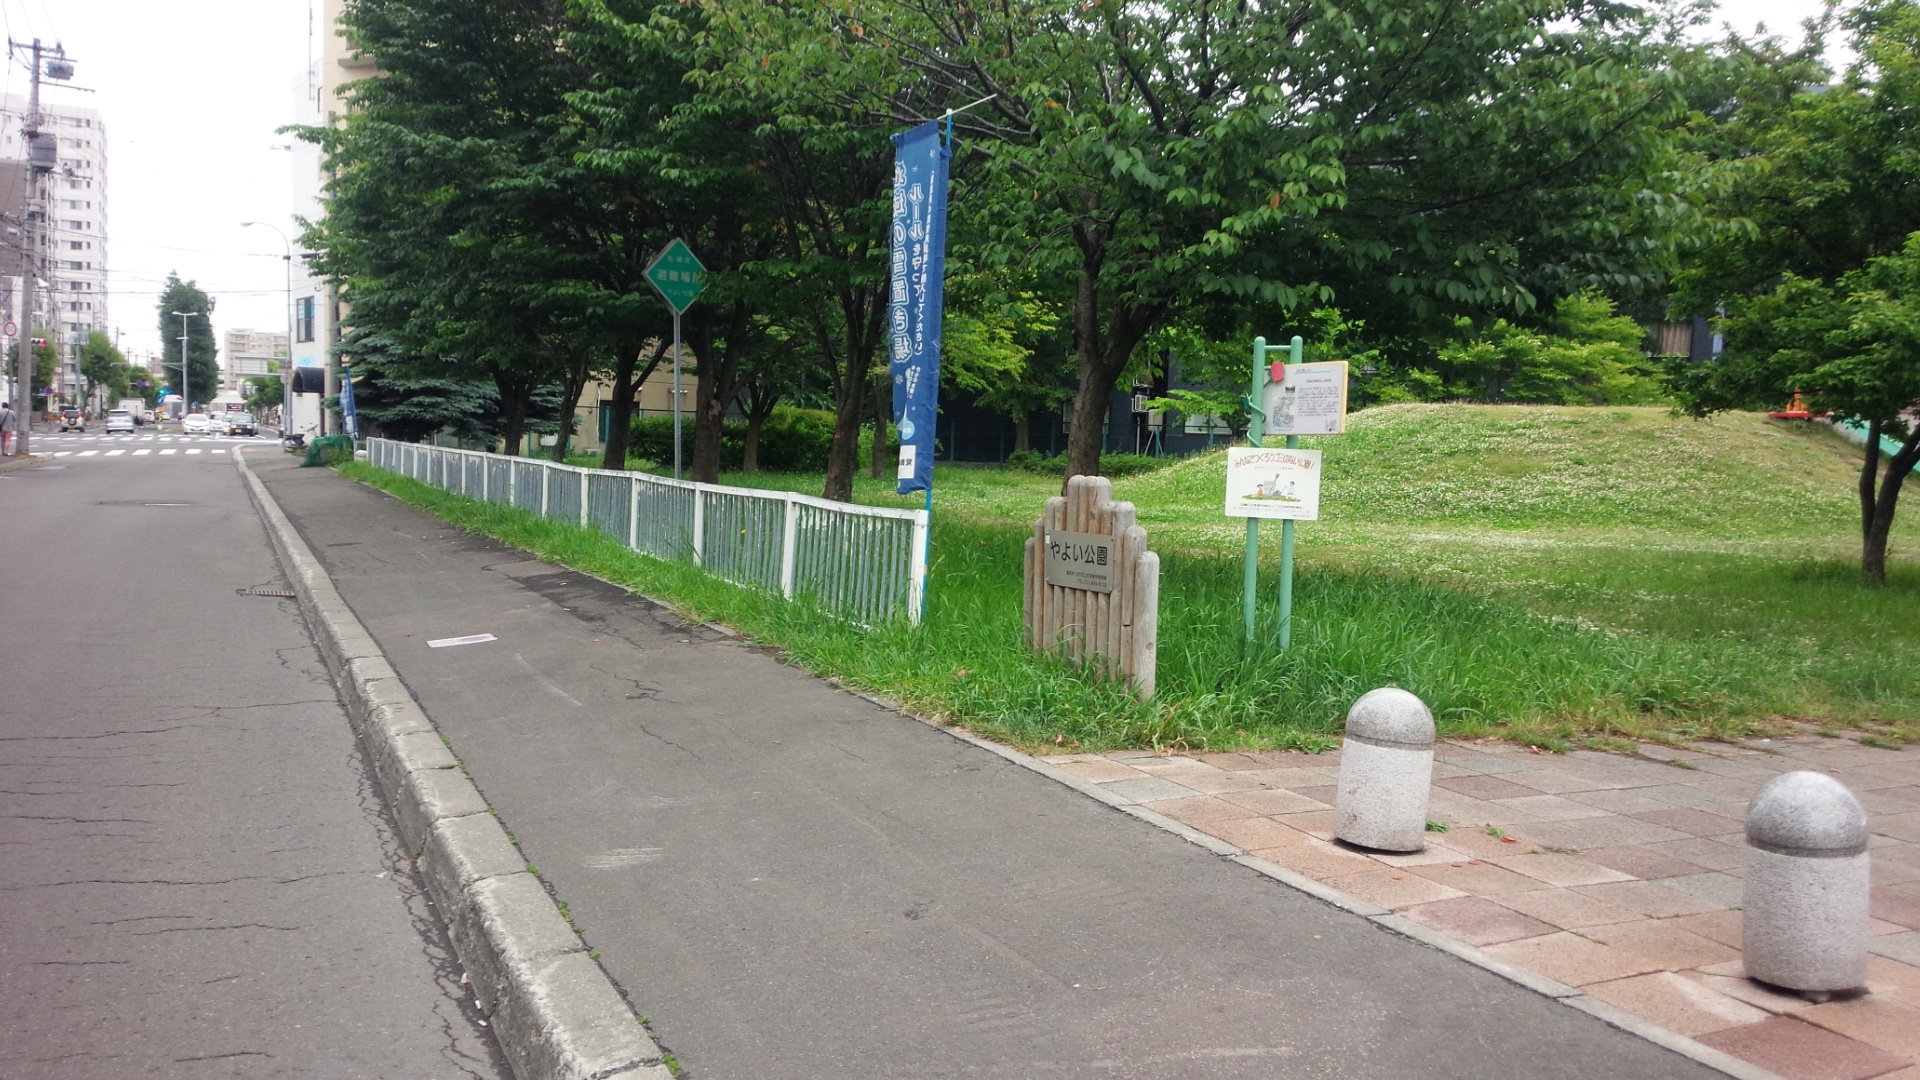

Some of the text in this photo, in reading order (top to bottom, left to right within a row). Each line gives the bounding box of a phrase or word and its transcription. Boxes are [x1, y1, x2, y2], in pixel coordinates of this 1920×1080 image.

[1050, 540, 1107, 566] やよい公園
